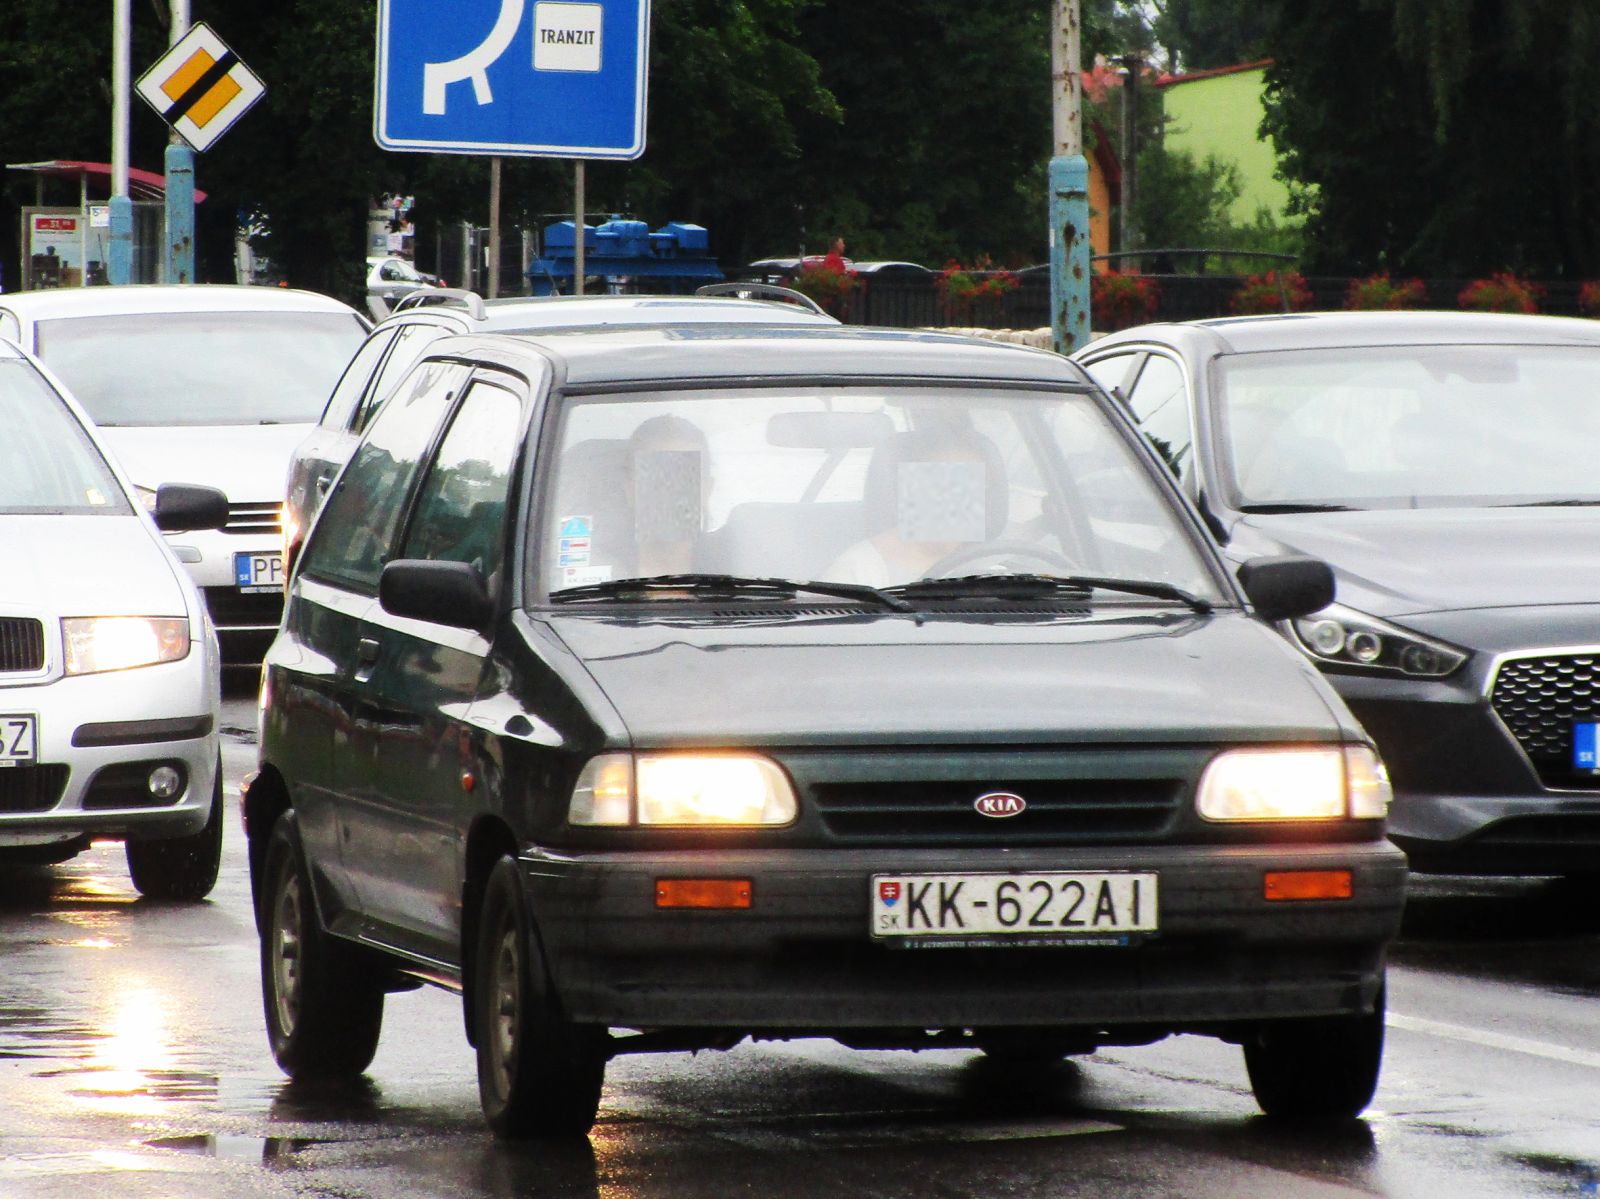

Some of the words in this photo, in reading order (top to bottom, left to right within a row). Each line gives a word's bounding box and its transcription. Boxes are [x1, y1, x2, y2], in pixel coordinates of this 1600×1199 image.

[541, 29, 595, 45] TRANZIT
[0, 721, 29, 756] Z
[983, 798, 1018, 812] KIA
[907, 879, 1140, 929] KK-622AI
[879, 914, 900, 930] SK
